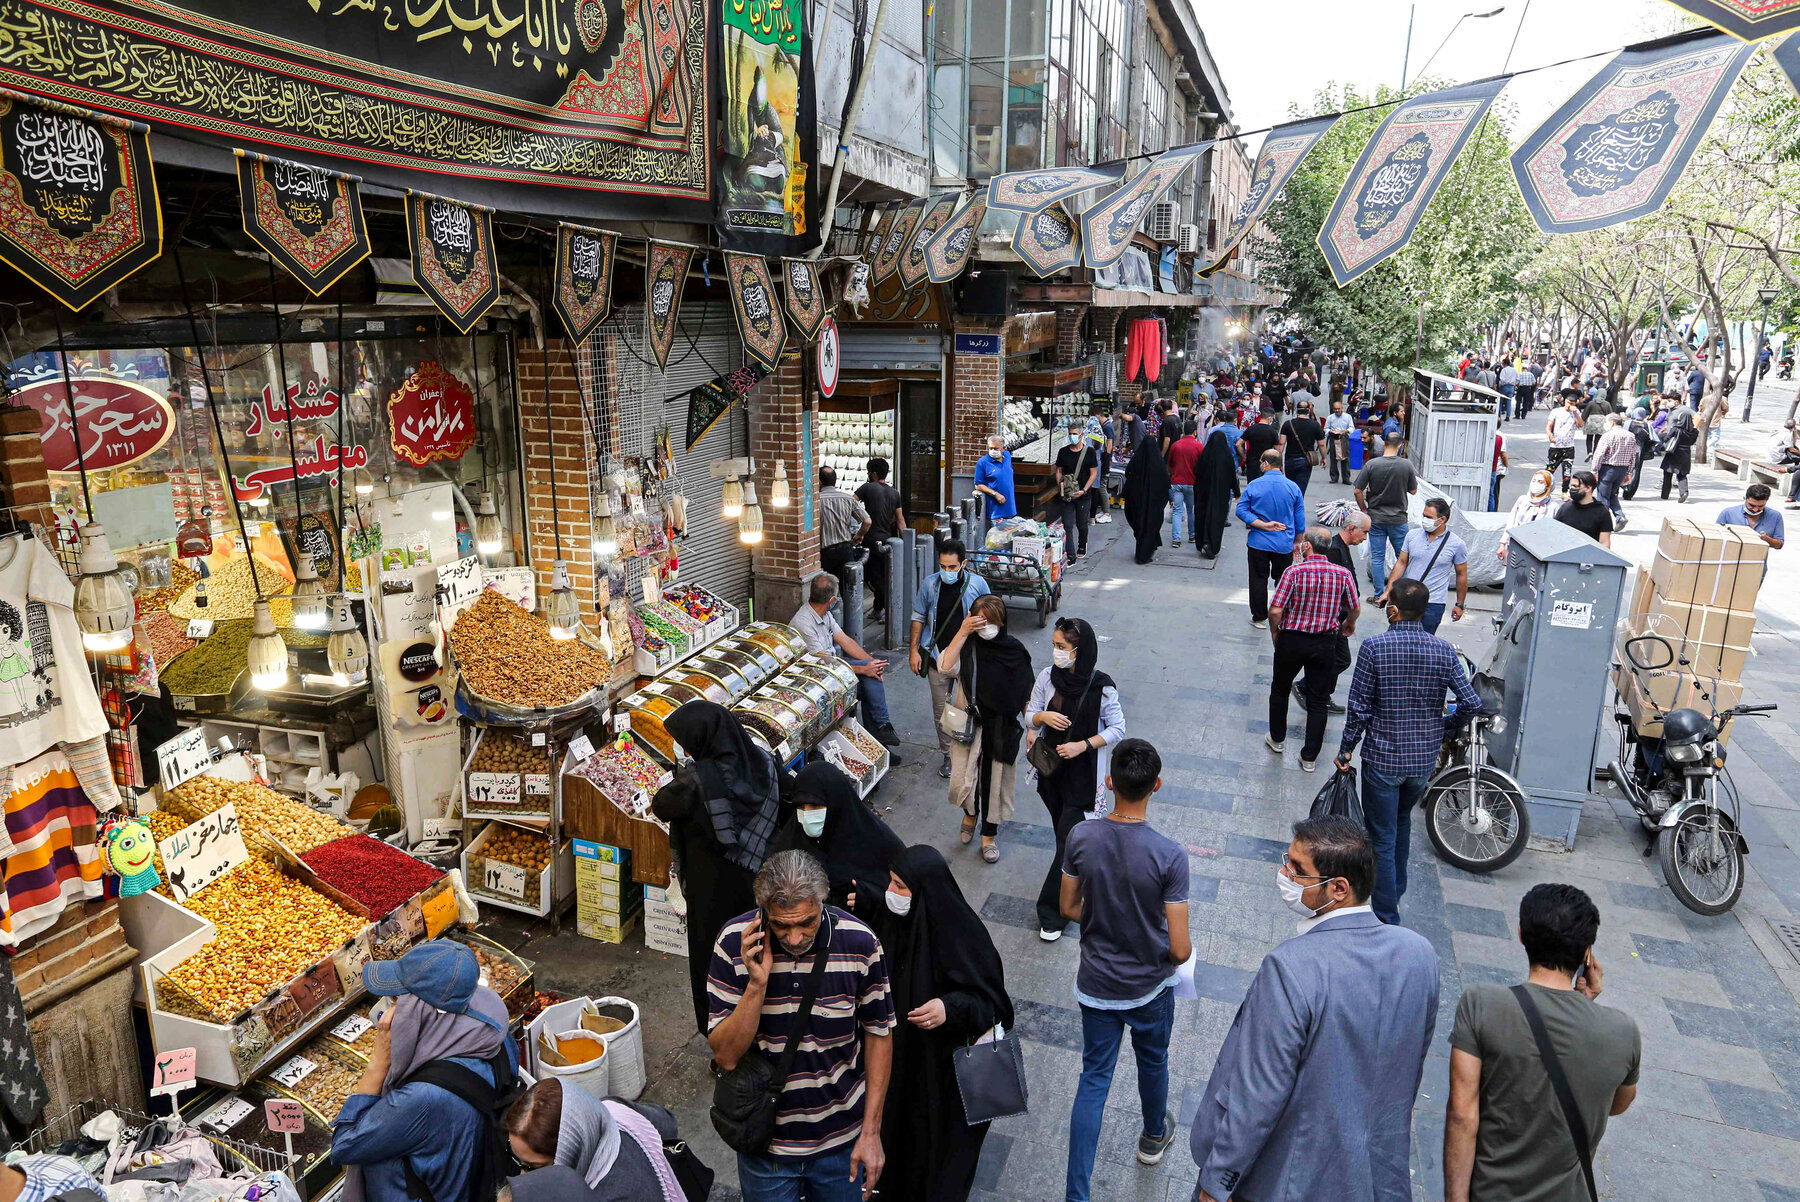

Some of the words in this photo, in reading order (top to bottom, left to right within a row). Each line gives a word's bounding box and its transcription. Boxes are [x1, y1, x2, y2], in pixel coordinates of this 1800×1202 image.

[968, 339, 990, 348] زرگرها
[419, 388, 443, 400] زعفران
[246, 377, 340, 438] خشکبار
[106, 441, 136, 458] ۱۳۱۱
[231, 434, 368, 502] مجلسی
[340, 608, 348, 622] 3
[346, 648, 354, 657] 3
[186, 729, 204, 752] انجیر
[499, 774, 520, 788] گردو
[496, 785, 520, 796] کاغذی
[282, 1103, 298, 1111] فقط
